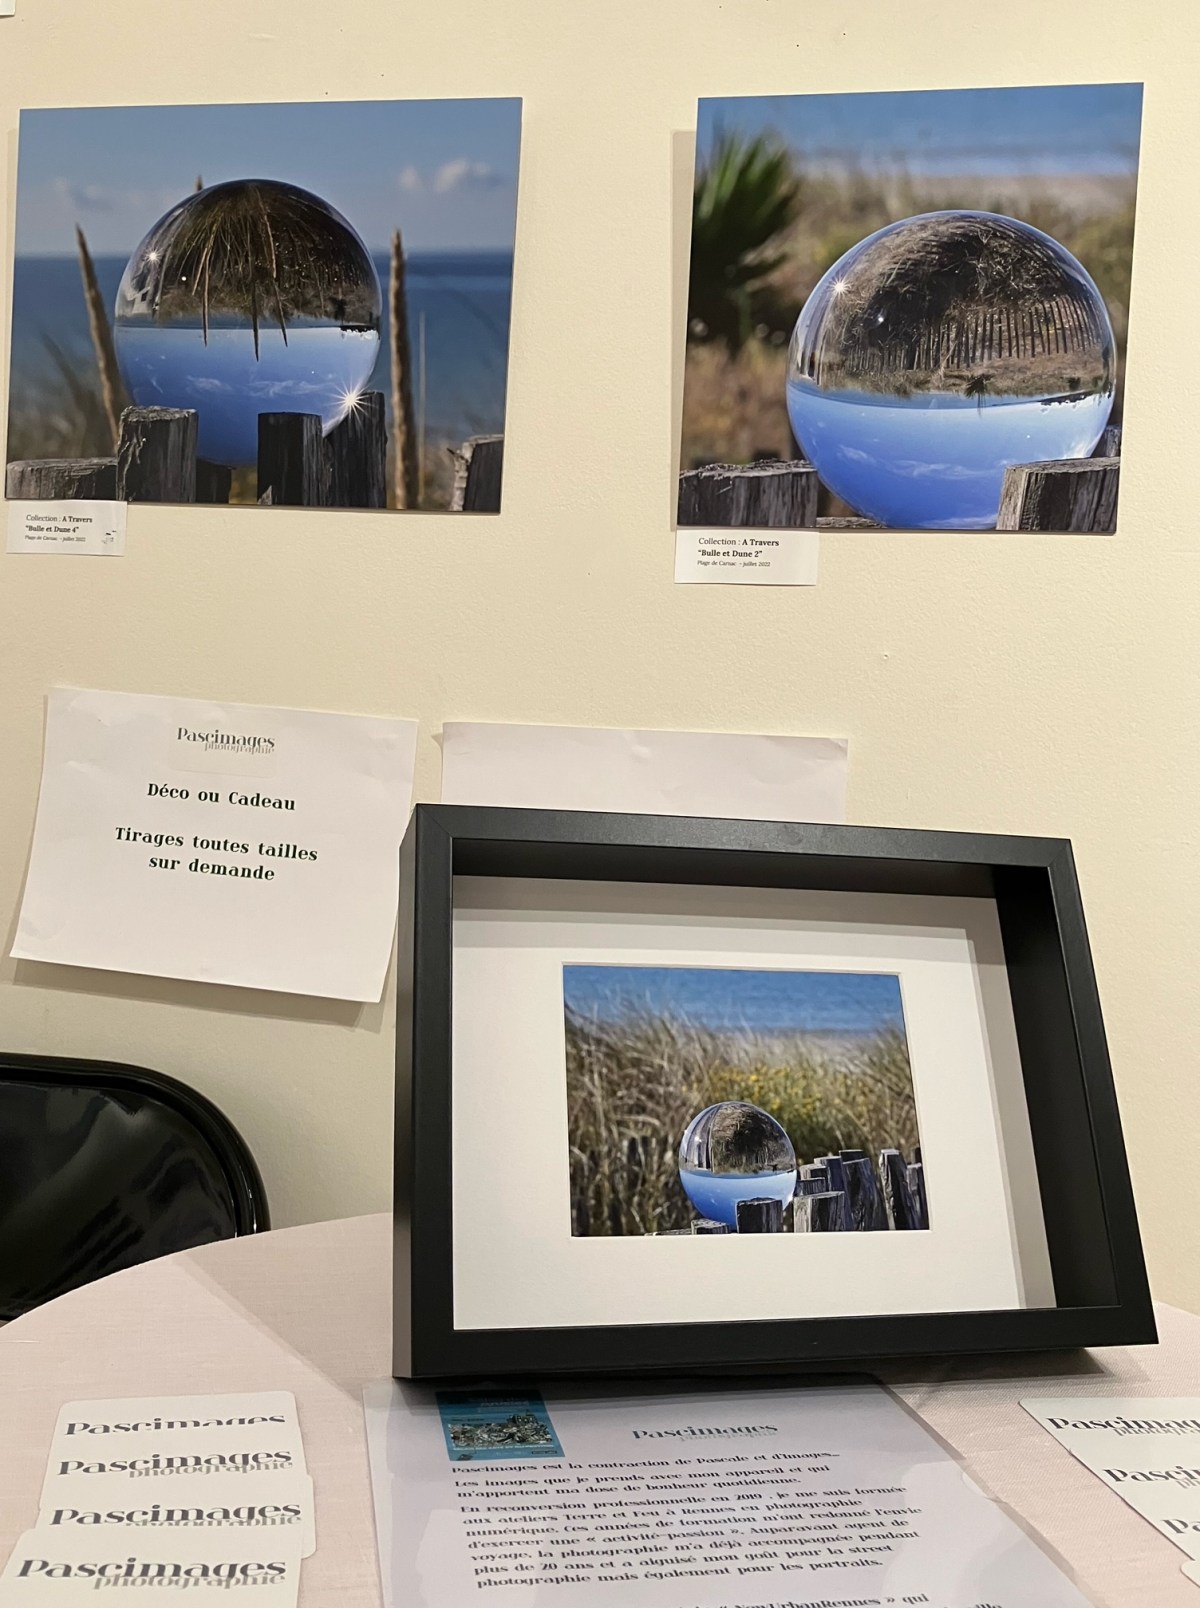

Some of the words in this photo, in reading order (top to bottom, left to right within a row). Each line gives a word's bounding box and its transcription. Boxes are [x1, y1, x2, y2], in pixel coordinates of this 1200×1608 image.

[26, 514, 58, 522] Collection
[61, 515, 68, 523] A
[68, 515, 93, 523] Travers
[698, 537, 736, 545] Collection
[177, 727, 276, 748] Pascimages
[147, 783, 190, 800] Déco
[198, 790, 219, 803] ou
[228, 791, 296, 811] Cadeau
[115, 827, 184, 847] Tirages
[193, 835, 250, 854] toutes
[258, 842, 318, 861] tailles
[149, 857, 180, 870] sur
[188, 858, 275, 881] demande
[632, 1424, 778, 1440] Pascimages
[57, 1450, 292, 1476] Pascimages
[128, 1460, 294, 1478] photographie
[452, 1462, 537, 1474] Pascimages
[543, 1462, 562, 1470] est
[569, 1461, 583, 1469] la
[588, 1458, 670, 1469] contraction
[674, 1458, 692, 1466] de
[697, 1455, 749, 1465] Pascale
[753, 1453, 768, 1461] et
[455, 1479, 479, 1487] Les
[485, 1478, 538, 1487] images
[543, 1476, 571, 1485] que
[576, 1476, 589, 1485] je
[595, 1474, 645, 1483] prends
[688, 1470, 720, 1478] mon
[725, 1467, 784, 1478] appareil
[807, 1464, 830, 1474] qui
[487, 1502, 586, 1512] reconversion
[593, 1495, 706, 1508] professionnelle
[735, 1493, 763, 1501] 2019
[776, 1491, 790, 1500] je
[795, 1490, 817, 1498] me
[822, 1488, 851, 1496] suis
[854, 1485, 907, 1495] formée
[585, 1486, 619, 1494] dose
[645, 1481, 708, 1491] bonheur
[50, 1504, 301, 1526] Pascimages
[462, 1517, 492, 1525] aux
[498, 1515, 558, 1524] ateliers
[562, 1513, 607, 1521] Terre
[632, 1510, 660, 1518] Feu
[665, 1508, 676, 1516] à
[682, 1507, 736, 1515] Rennes
[766, 1498, 863, 1512] photographie
[563, 1525, 589, 1533] Ces
[594, 1522, 651, 1532] années
[655, 1520, 674, 1528] de
[679, 1515, 757, 1526] formation
[809, 1509, 871, 1520] redonné
[750, 1522, 838, 1535] Auparavant
[844, 1519, 886, 1529] agent
[891, 1518, 909, 1527] de
[537, 1550, 553, 1558] la
[560, 1544, 669, 1558] photographie
[709, 1539, 742, 1549] déjà
[748, 1534, 853, 1547] accompagnée
[859, 1530, 921, 1541] pendant
[16, 1557, 286, 1578] Pascimages
[474, 1565, 509, 1576] plus
[514, 1563, 534, 1571] de
[541, 1562, 557, 1571] 20
[564, 1562, 594, 1570] ans
[600, 1560, 614, 1568] et
[639, 1555, 697, 1567] aiguisé
[744, 1550, 779, 1561] goût
[785, 1549, 822, 1559] pour
[827, 1547, 843, 1555] la
[848, 1544, 895, 1554] street
[93, 1574, 286, 1590] photographie
[477, 1575, 591, 1589] photographie
[598, 1573, 639, 1582] mais
[644, 1567, 731, 1581] également
[737, 1564, 775, 1575] pour
[780, 1562, 803, 1571] les
[809, 1558, 883, 1571] portraits.
[902, 1593, 930, 1604] qui
